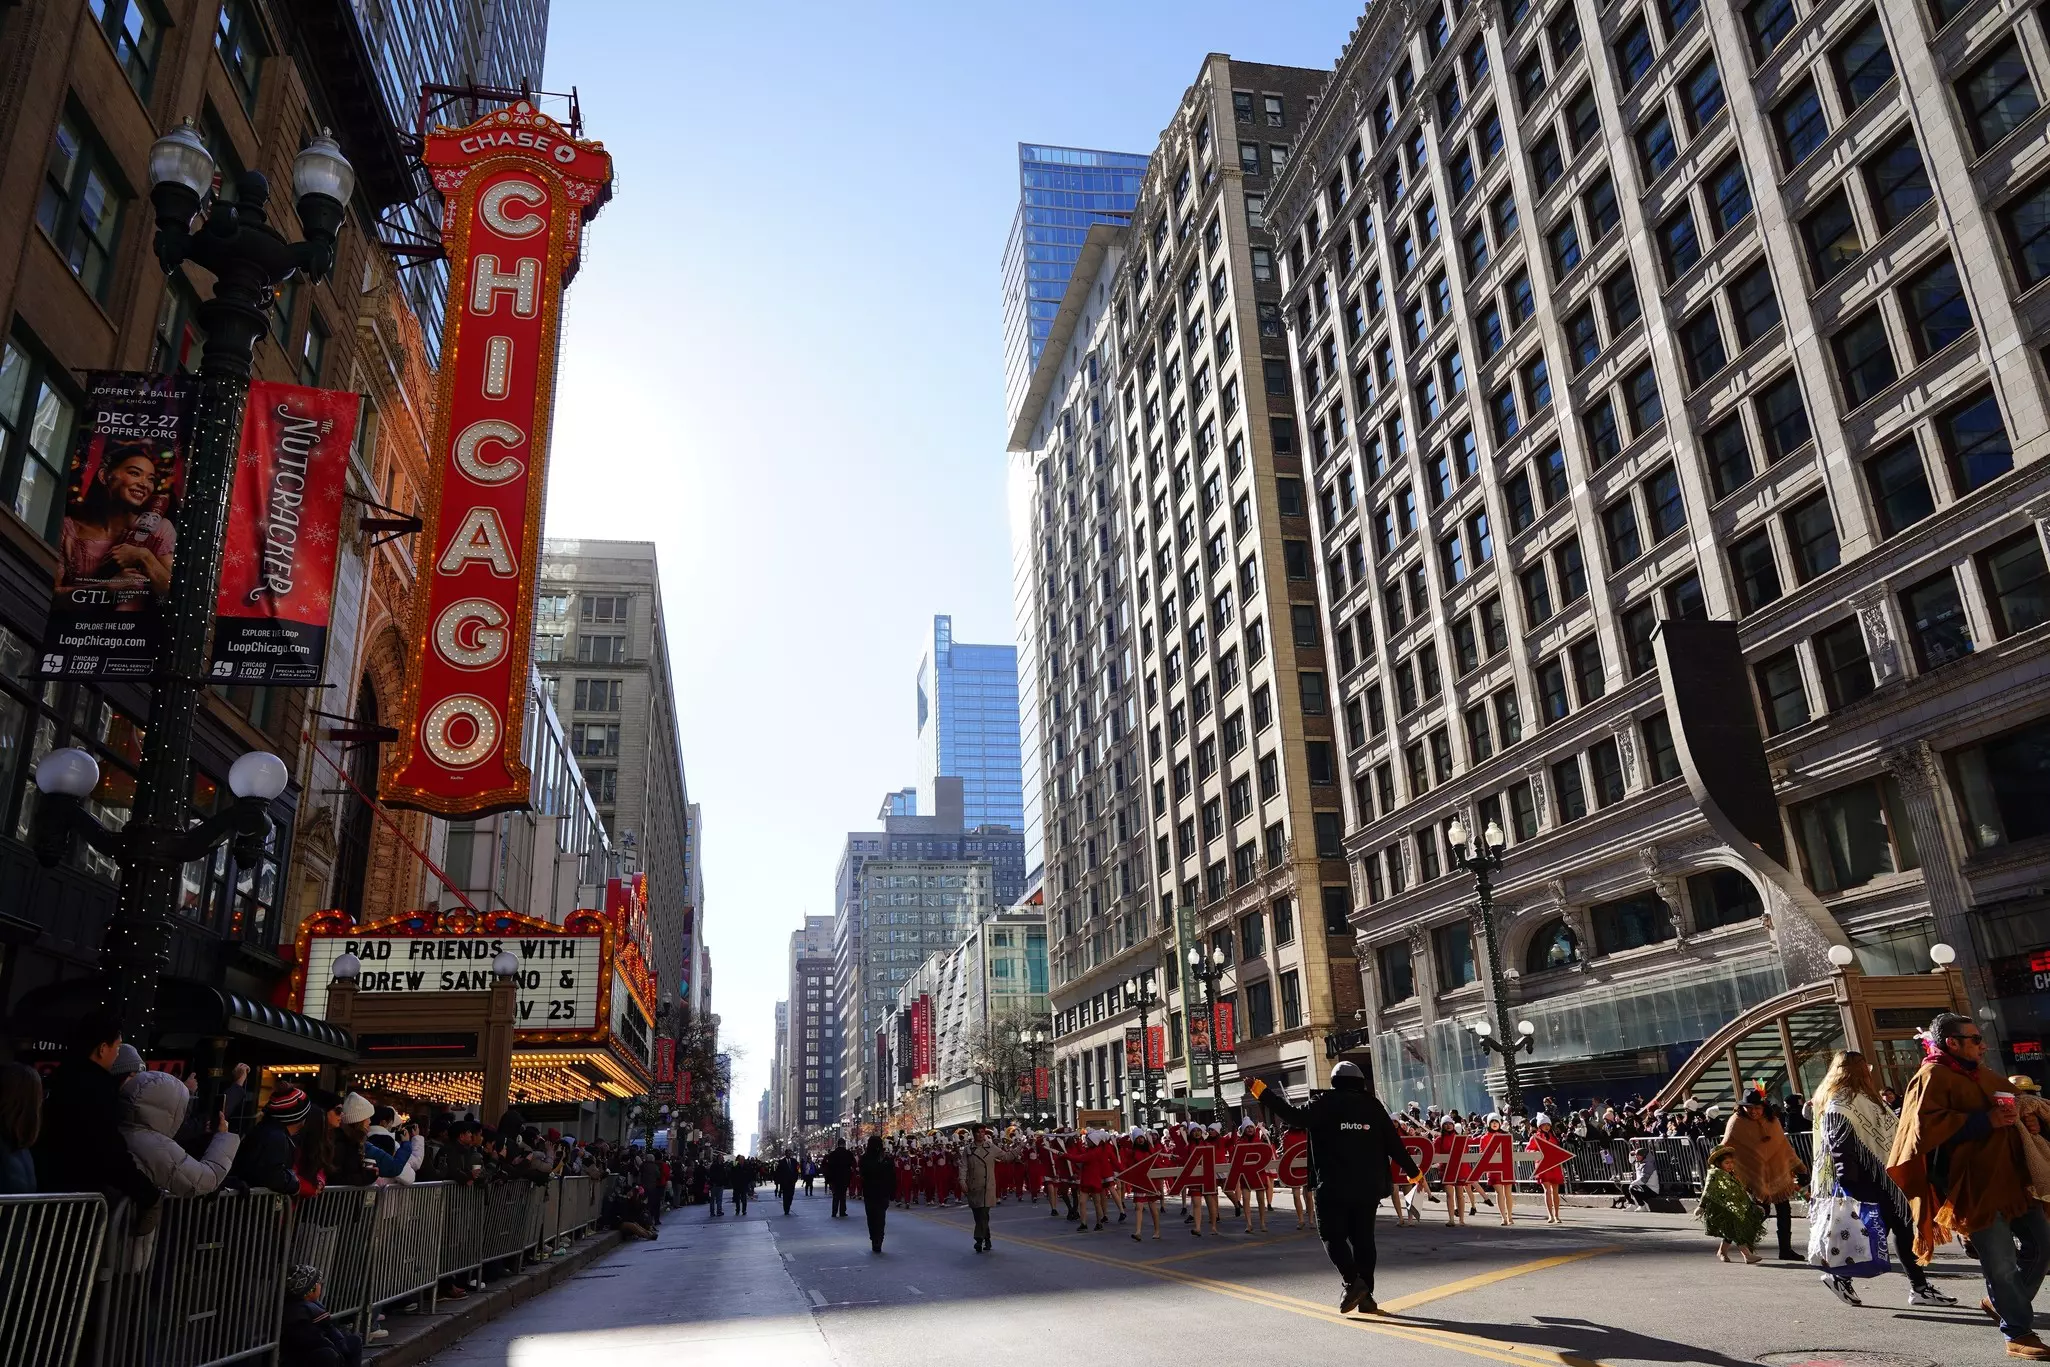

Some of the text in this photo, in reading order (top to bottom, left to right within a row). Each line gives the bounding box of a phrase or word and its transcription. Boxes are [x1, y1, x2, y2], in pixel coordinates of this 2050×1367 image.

[459, 131, 552, 154] CHASE
[92, 387, 187, 398] JOFFREY BALLET
[97, 411, 134, 426] DEC
[94, 425, 177, 439] JOFFREY.ORG
[320, 418, 334, 435] THE
[421, 180, 547, 770] CHICAGO
[250, 404, 321, 601] NUTCRACKER
[71, 589, 110, 604] GTL
[75, 622, 135, 631] EXPLORE THE LOOP
[241, 628, 270, 637] EXPLORE
[281, 629, 299, 638] LOOP
[59, 634, 146, 648] LoopChicago.com
[227, 640, 310, 656] LoopChicago.com
[70, 661, 98, 670] LOOP
[240, 667, 265, 676] LOOP
[1183, 911, 1193, 949] GENE
[345, 939, 576, 961] BAD FRIENDS WITH
[441, 969, 541, 992] SANTNO
[559, 969, 575, 989] &
[548, 999, 576, 1020] 25
[2014, 1051, 2043, 1062] CHICAGO
[1340, 1121, 1363, 1131] pluto
[1169, 1133, 1516, 1196] ARCDIA
